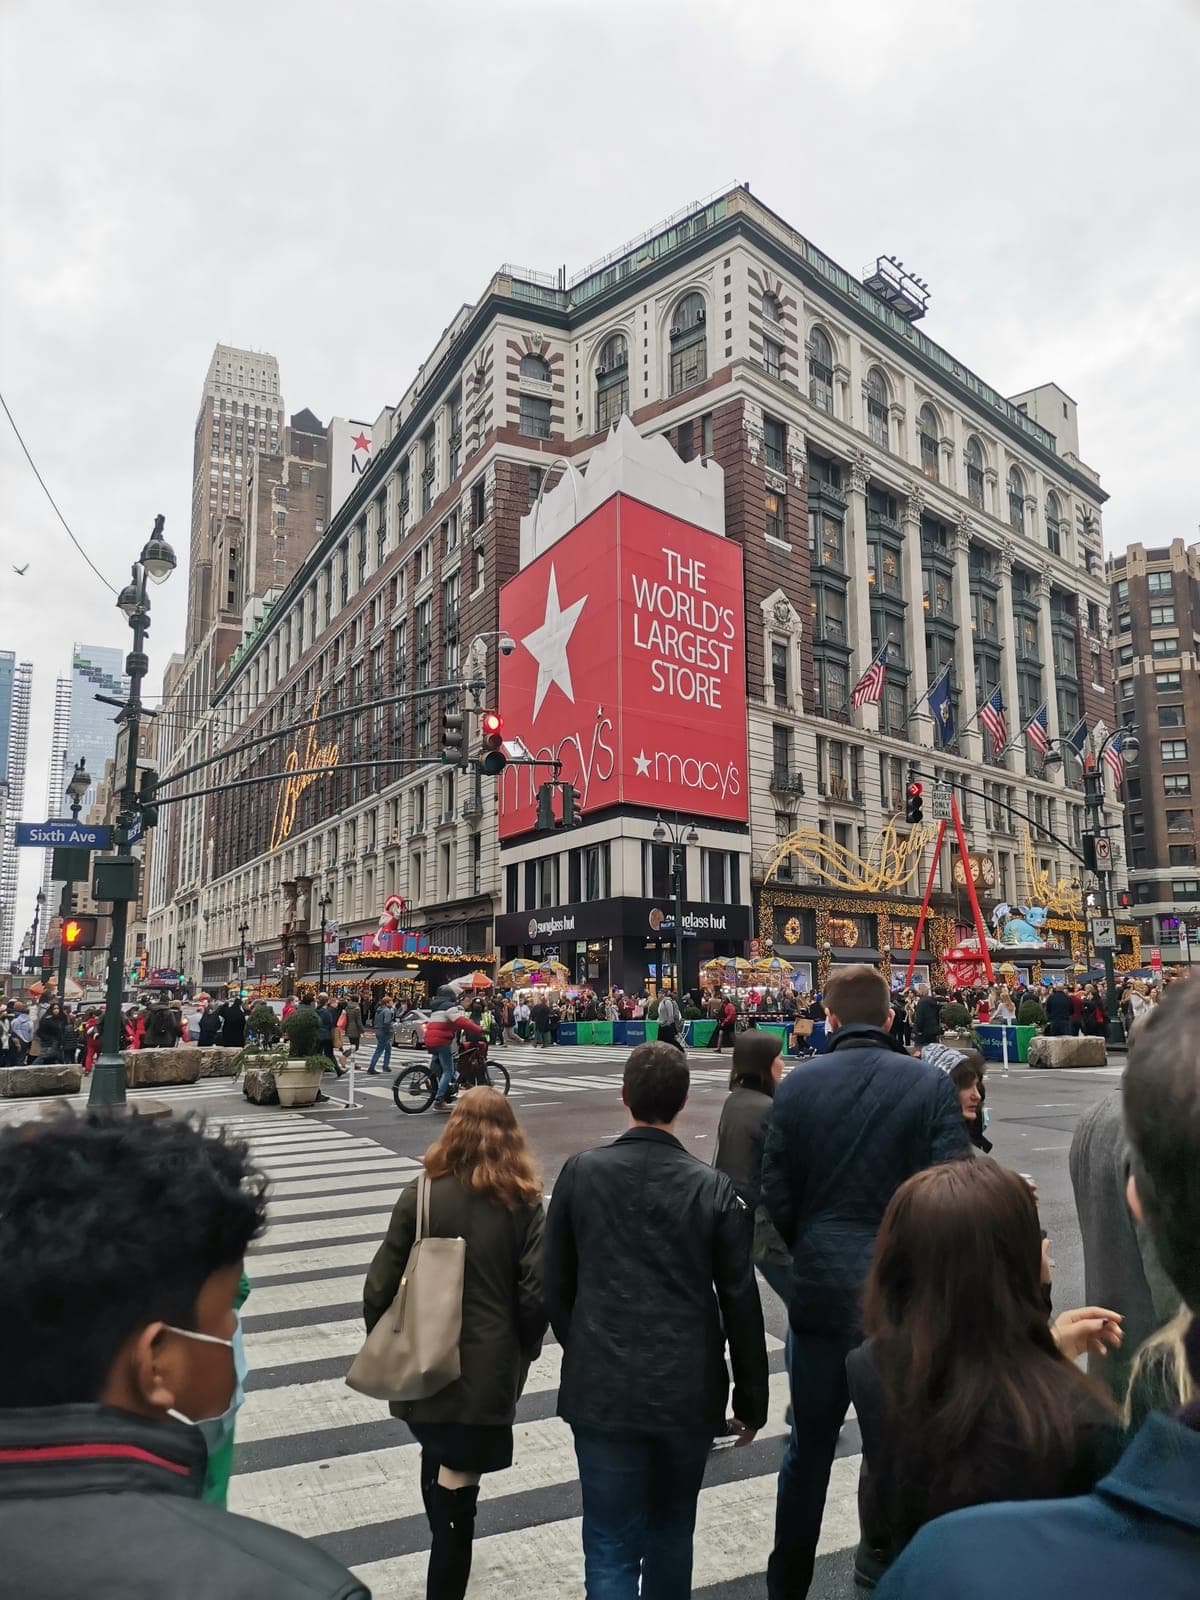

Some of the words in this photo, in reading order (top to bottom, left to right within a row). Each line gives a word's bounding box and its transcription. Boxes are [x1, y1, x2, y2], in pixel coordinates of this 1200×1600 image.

[661, 547, 707, 595] THE
[631, 573, 735, 640] WORLD'S
[634, 613, 734, 675] LARGEST
[651, 659, 722, 709] STORE
[655, 751, 740, 800] macy's
[933, 792, 951, 800] BUSES
[934, 801, 950, 809] ONLY
[29, 829, 65, 841] Sixth
[68, 830, 96, 843] Ave
[537, 916, 563, 937] sunglass
[563, 914, 575, 930] hut
[710, 913, 727, 930] hut
[429, 945, 462, 955] macy's
